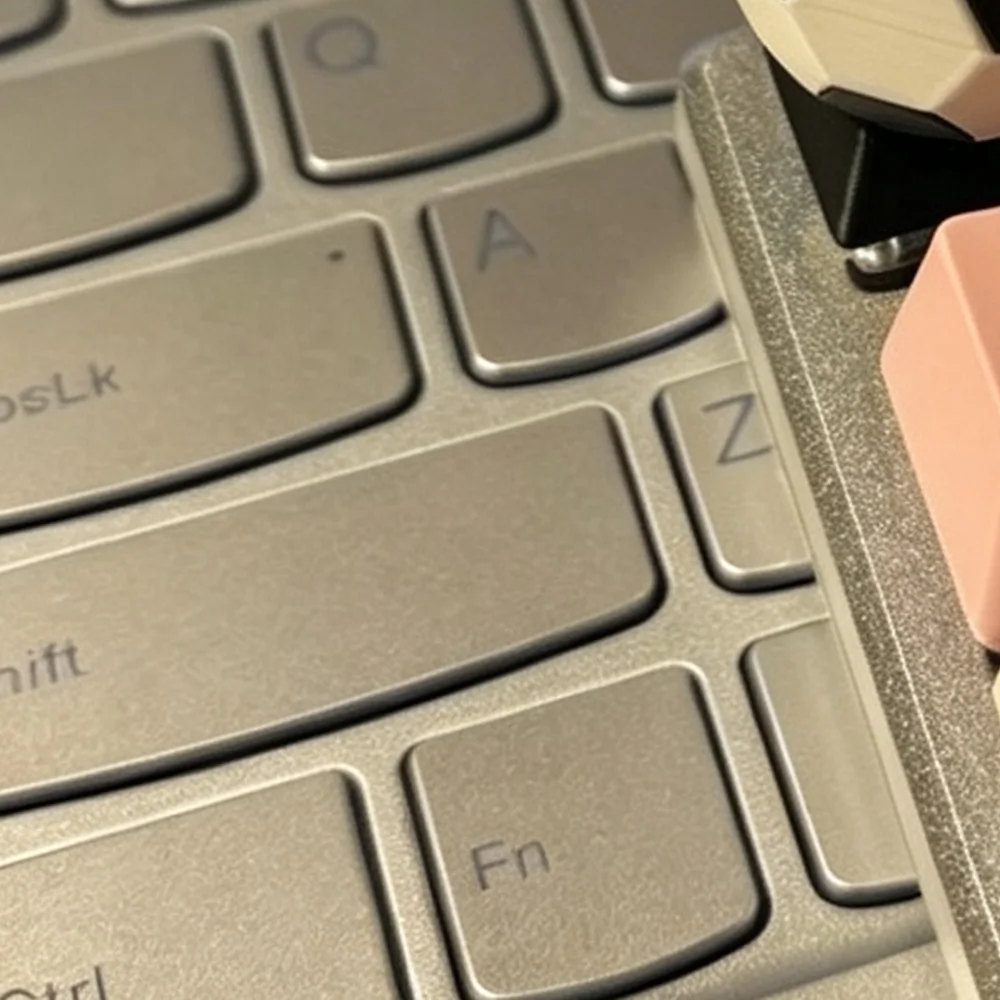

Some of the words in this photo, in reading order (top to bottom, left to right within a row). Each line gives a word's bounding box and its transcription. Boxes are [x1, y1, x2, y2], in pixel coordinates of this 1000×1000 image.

[303, 15, 381, 74] Q
[475, 207, 539, 274] A
[700, 391, 774, 467] Z
[471, 839, 550, 892] Fn
